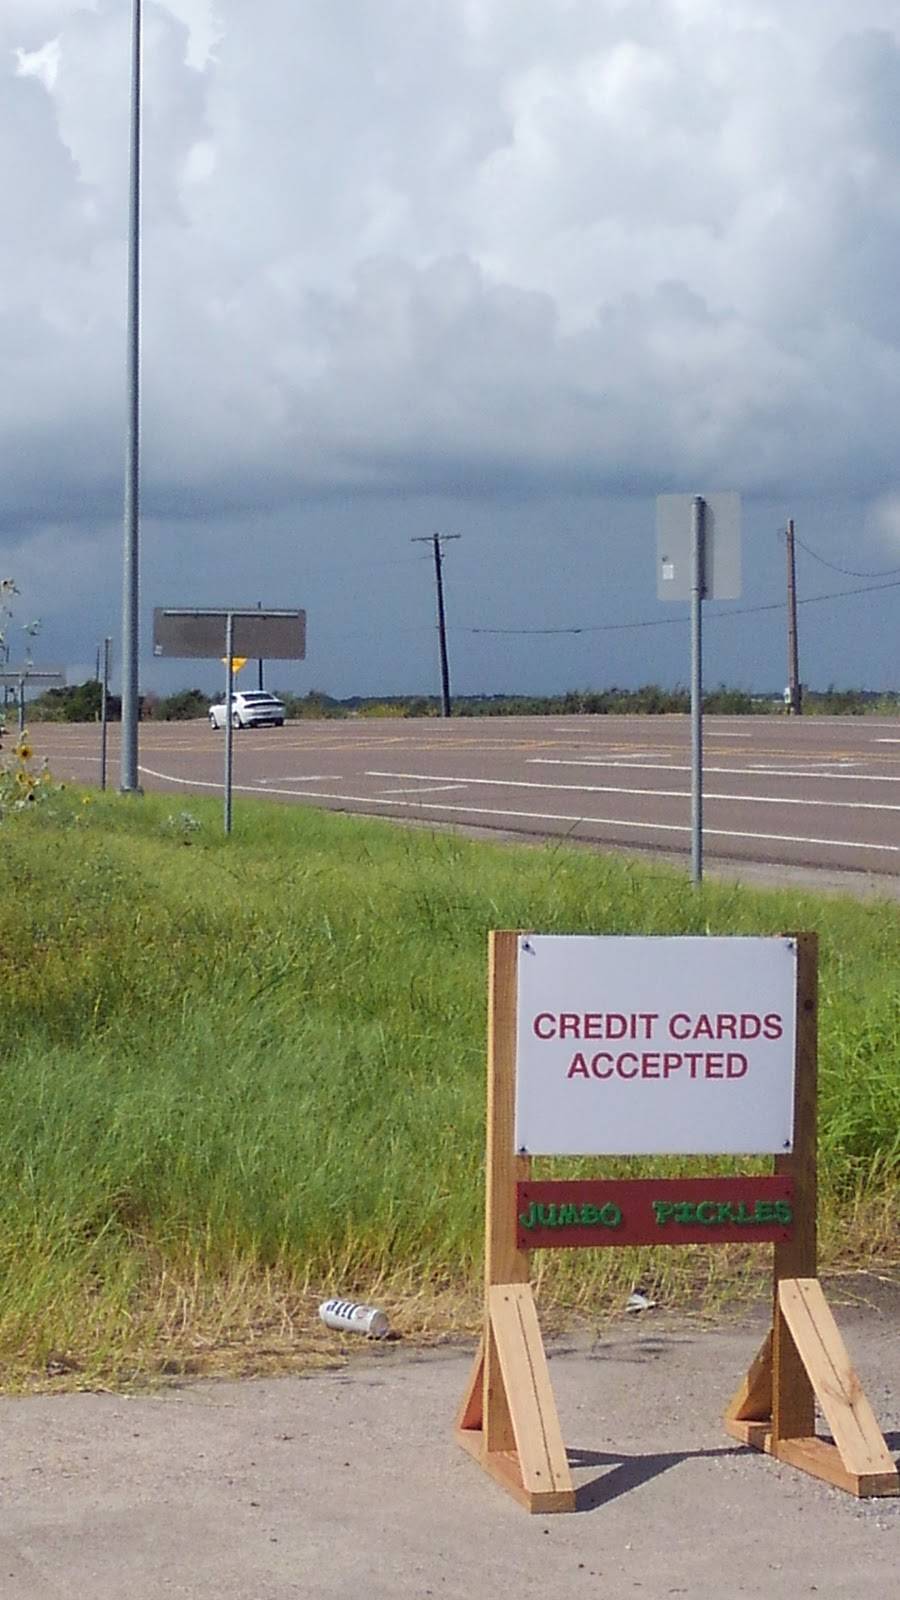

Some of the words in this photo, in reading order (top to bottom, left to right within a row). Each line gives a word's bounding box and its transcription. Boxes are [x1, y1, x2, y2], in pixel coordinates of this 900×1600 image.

[533, 1013, 658, 1039] CREDIT
[668, 1013, 783, 1039] CARDS
[567, 1053, 748, 1078] ACCEPTED
[520, 1202, 622, 1229] JUMBO
[652, 1200, 791, 1225] PICKLES
